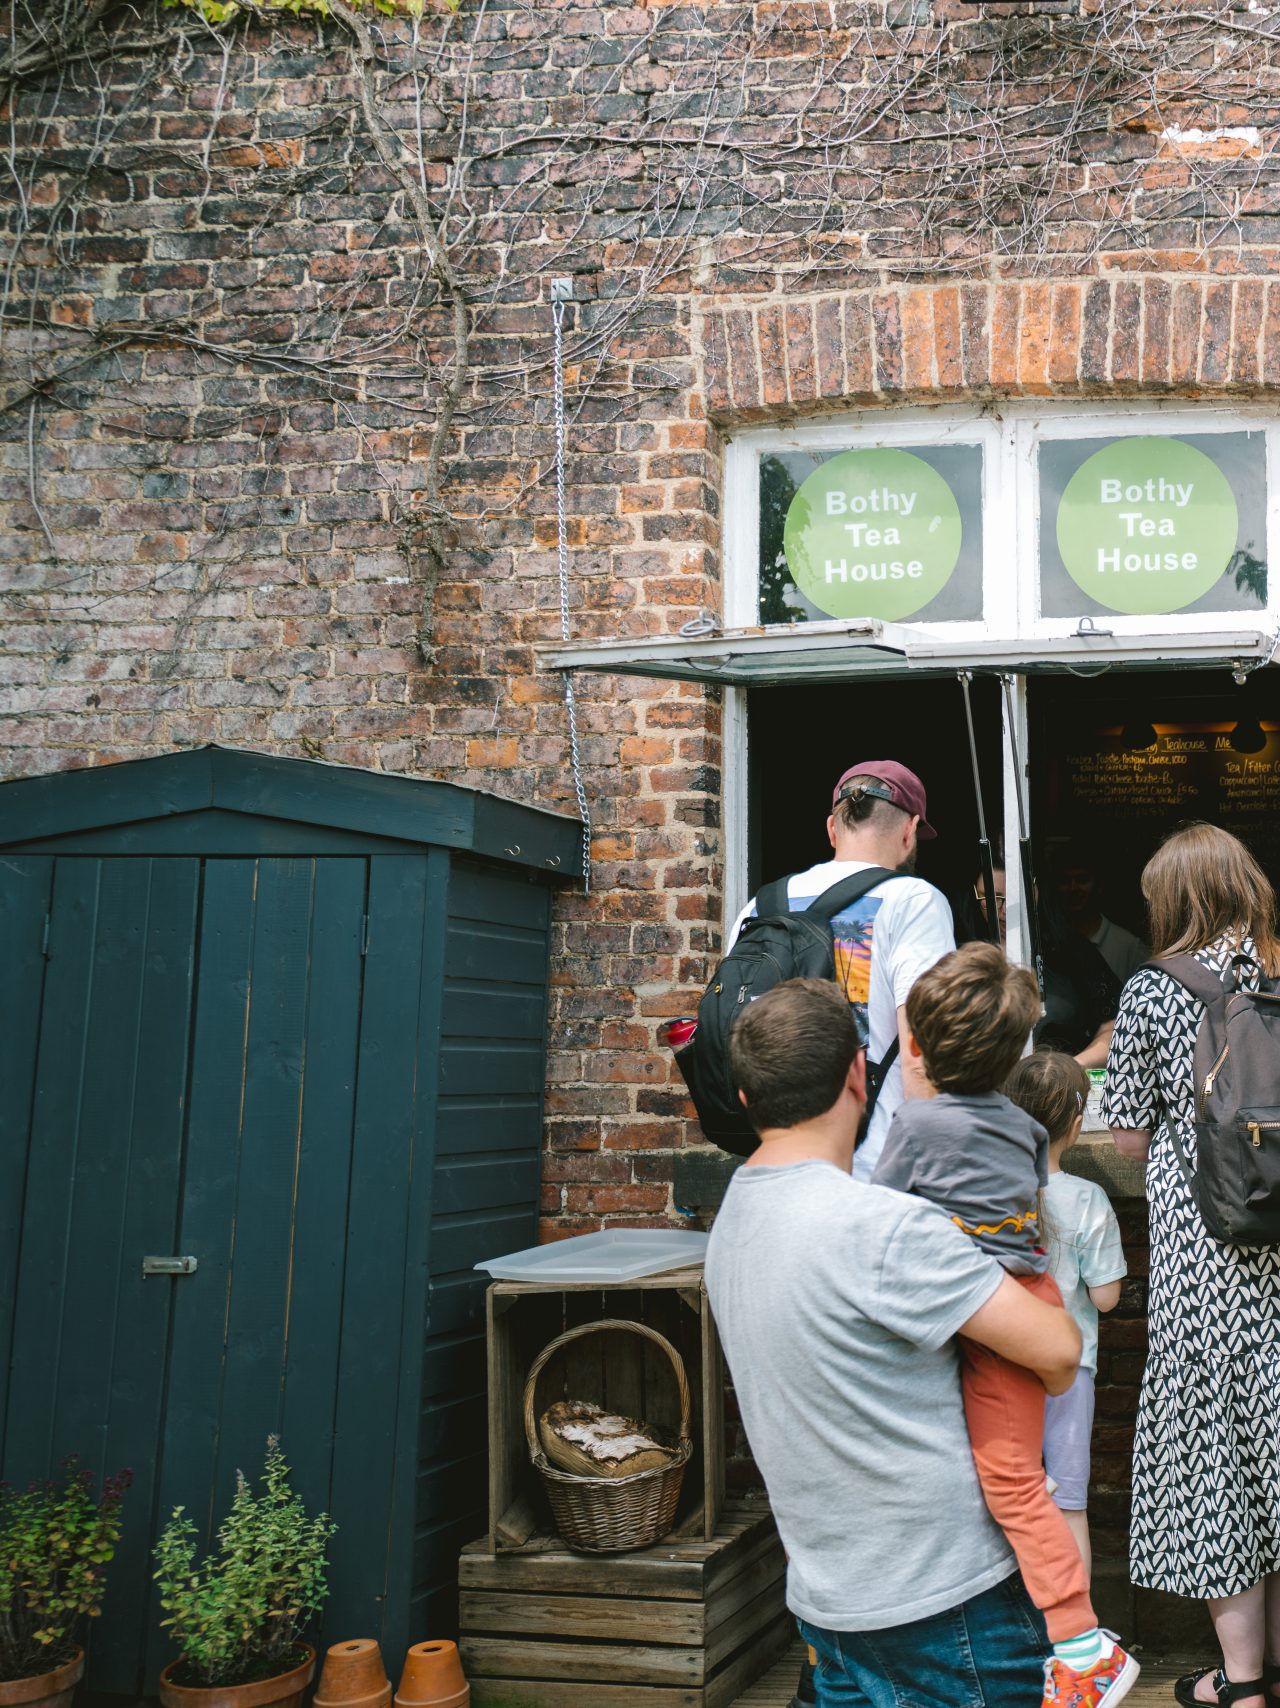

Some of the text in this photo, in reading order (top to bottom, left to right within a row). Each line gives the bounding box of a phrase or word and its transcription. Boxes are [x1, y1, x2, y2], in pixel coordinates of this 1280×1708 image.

[826, 488, 917, 516] Bothy
[1101, 478, 1194, 507] Bothy
[845, 523, 900, 547] Tea
[1119, 513, 1175, 537] Tea
[825, 559, 923, 583] House
[1097, 548, 1197, 572] House
[1225, 762, 1241, 774] Tea
[1248, 760, 1271, 773] Filter
